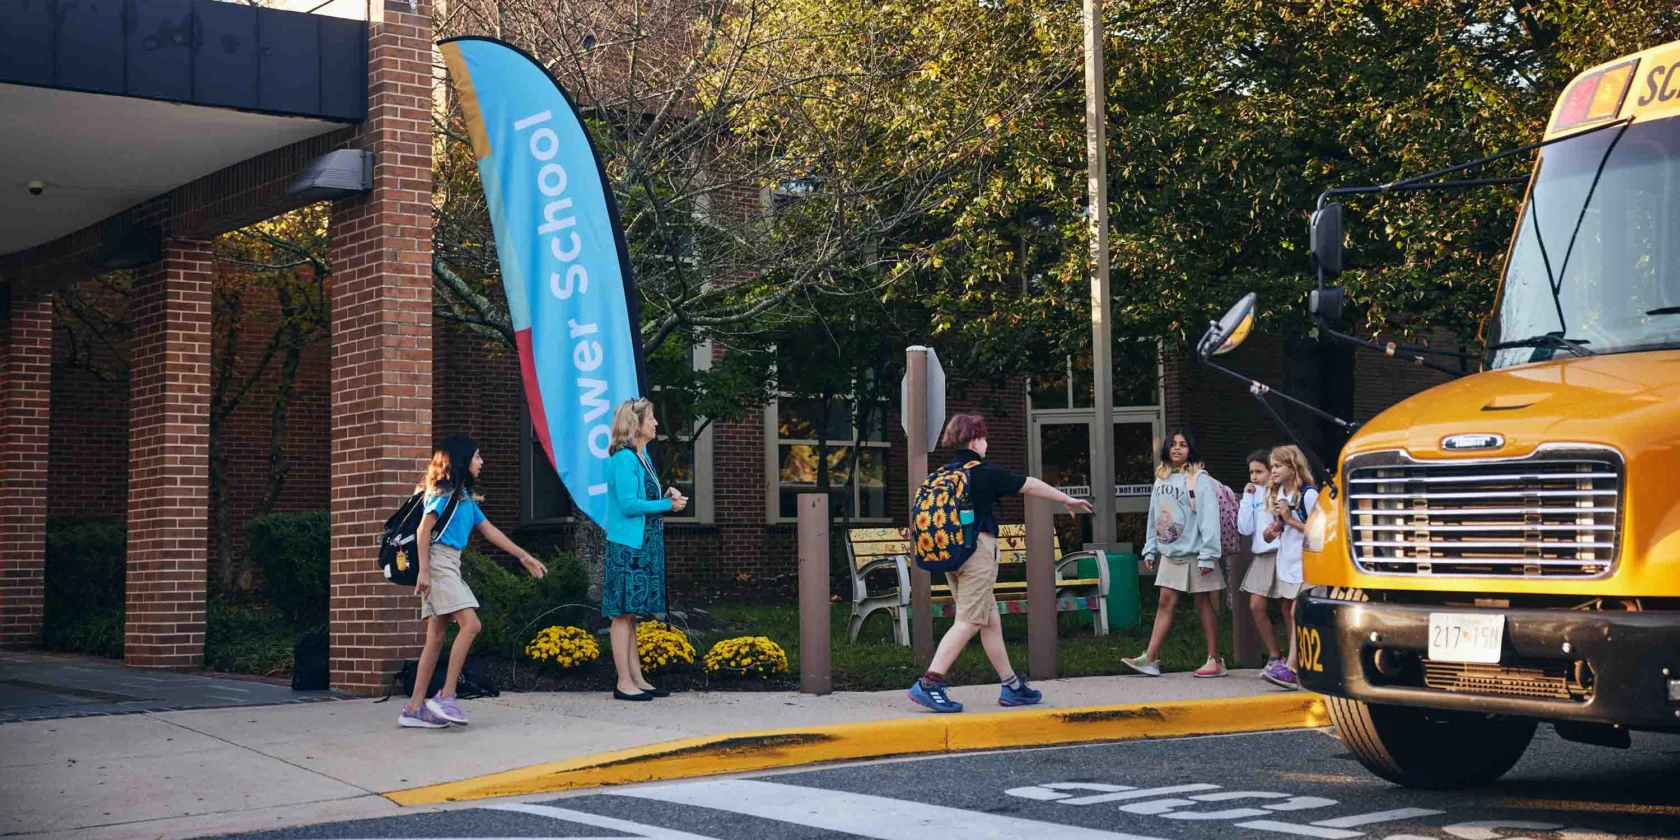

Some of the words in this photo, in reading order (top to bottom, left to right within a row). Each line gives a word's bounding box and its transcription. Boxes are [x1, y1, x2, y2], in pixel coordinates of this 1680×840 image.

[1638, 62, 1680, 107] SC
[514, 109, 589, 301] School
[1069, 487, 1088, 496] ENTER
[1132, 485, 1152, 494] ENTER
[1297, 624, 1323, 672] 302
[1433, 625, 1462, 648] 217
